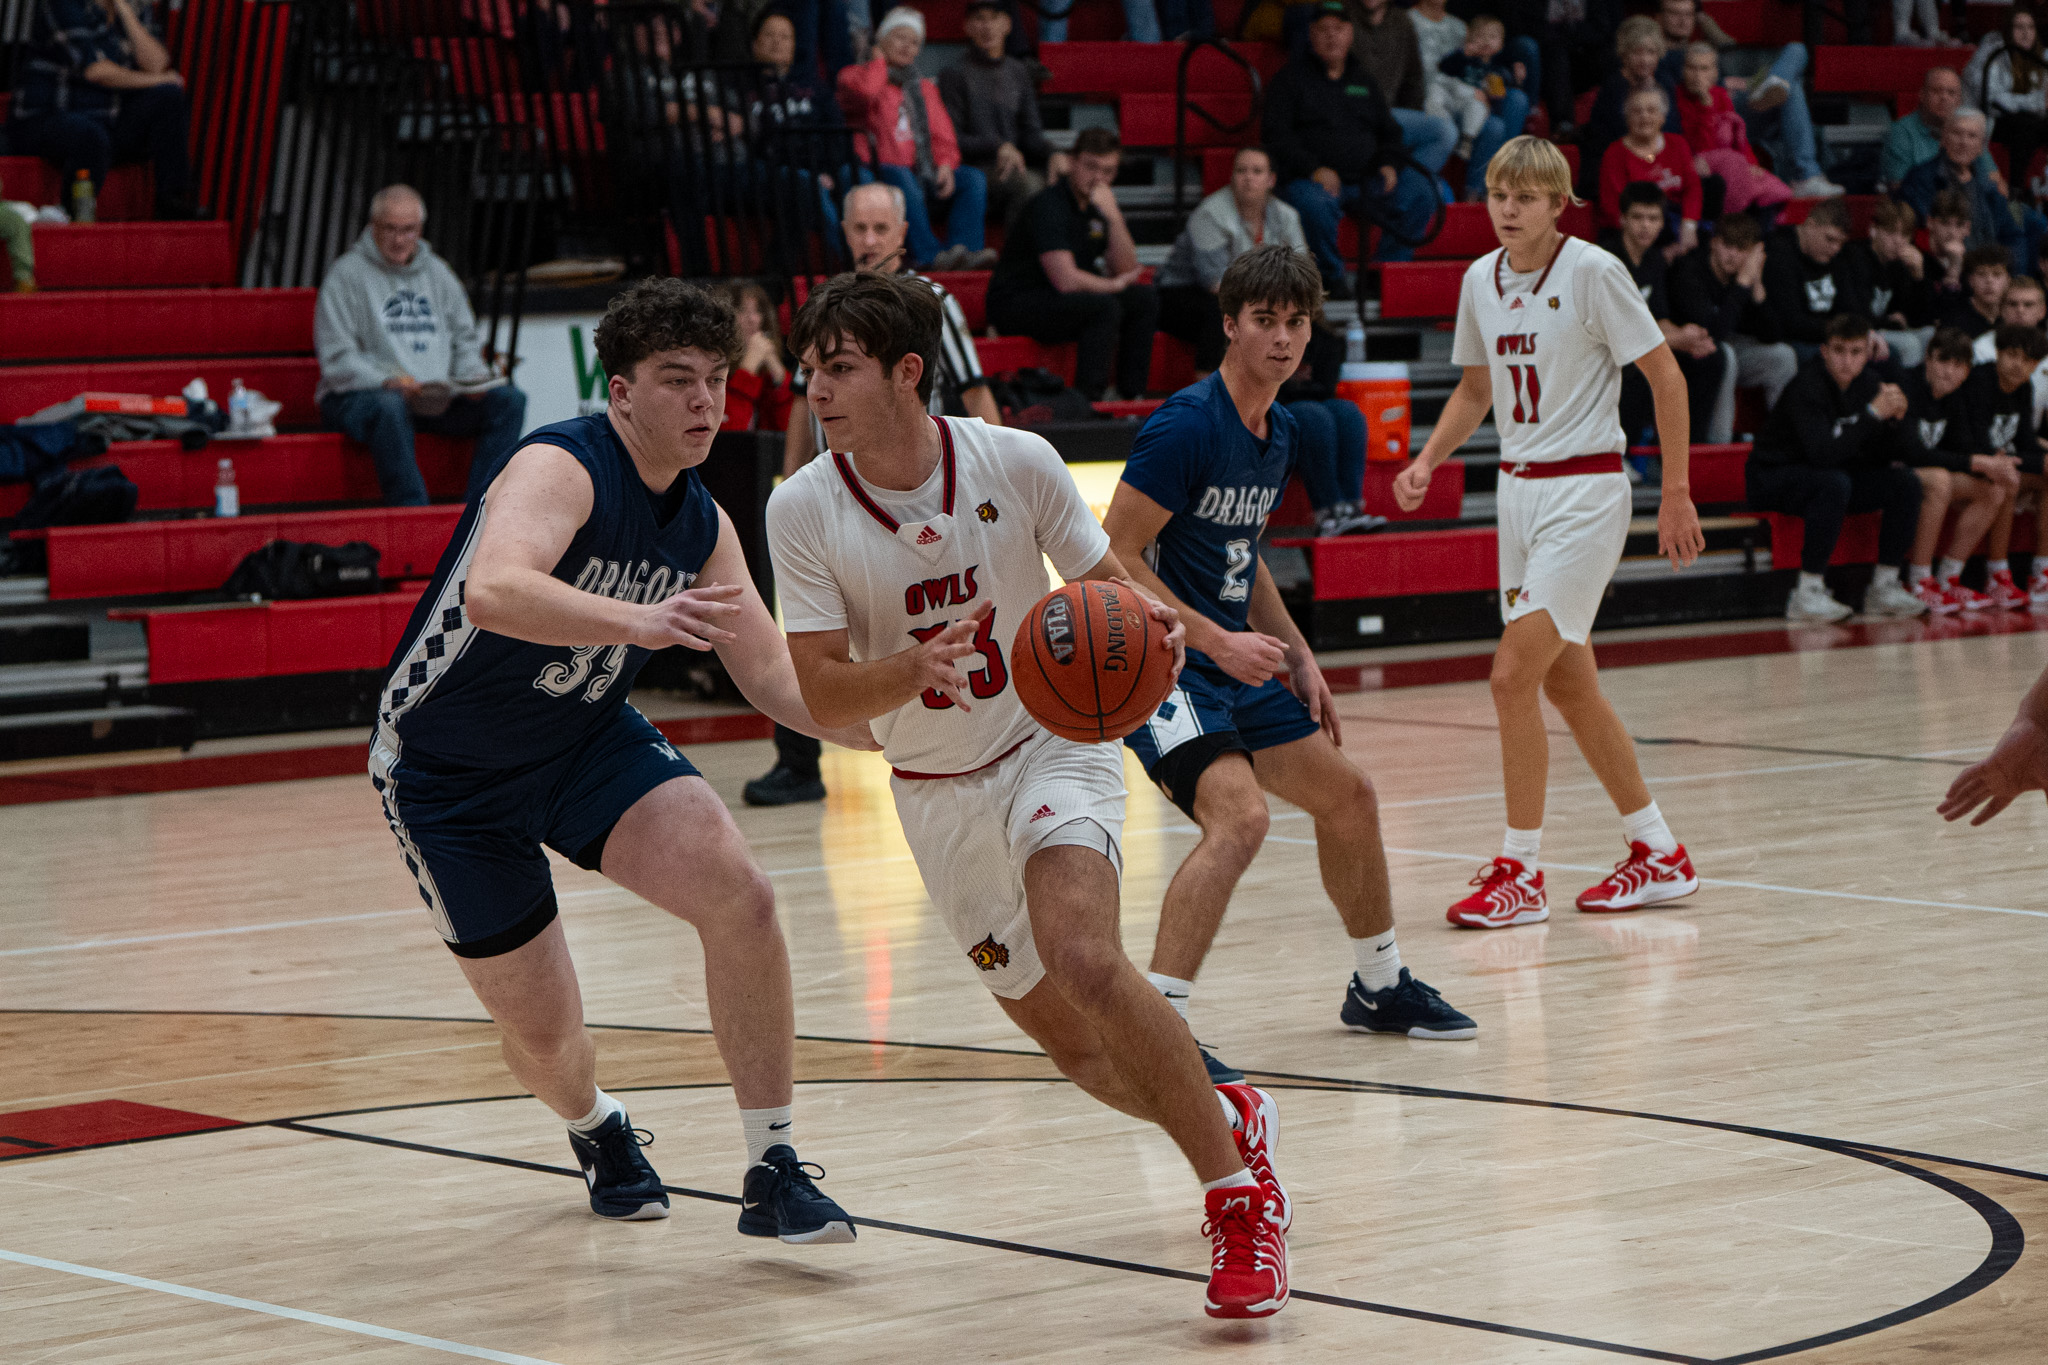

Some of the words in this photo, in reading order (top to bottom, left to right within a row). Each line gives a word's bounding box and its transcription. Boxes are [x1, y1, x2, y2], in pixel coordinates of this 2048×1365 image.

[1496, 332, 1538, 356] OWLS
[1506, 364, 1541, 423] 11
[916, 534, 943, 545] adidas
[905, 564, 979, 616] OWLS
[1219, 539, 1252, 602] 2
[1046, 600, 1073, 660] PIAA
[1092, 582, 1128, 672] SPALDING
